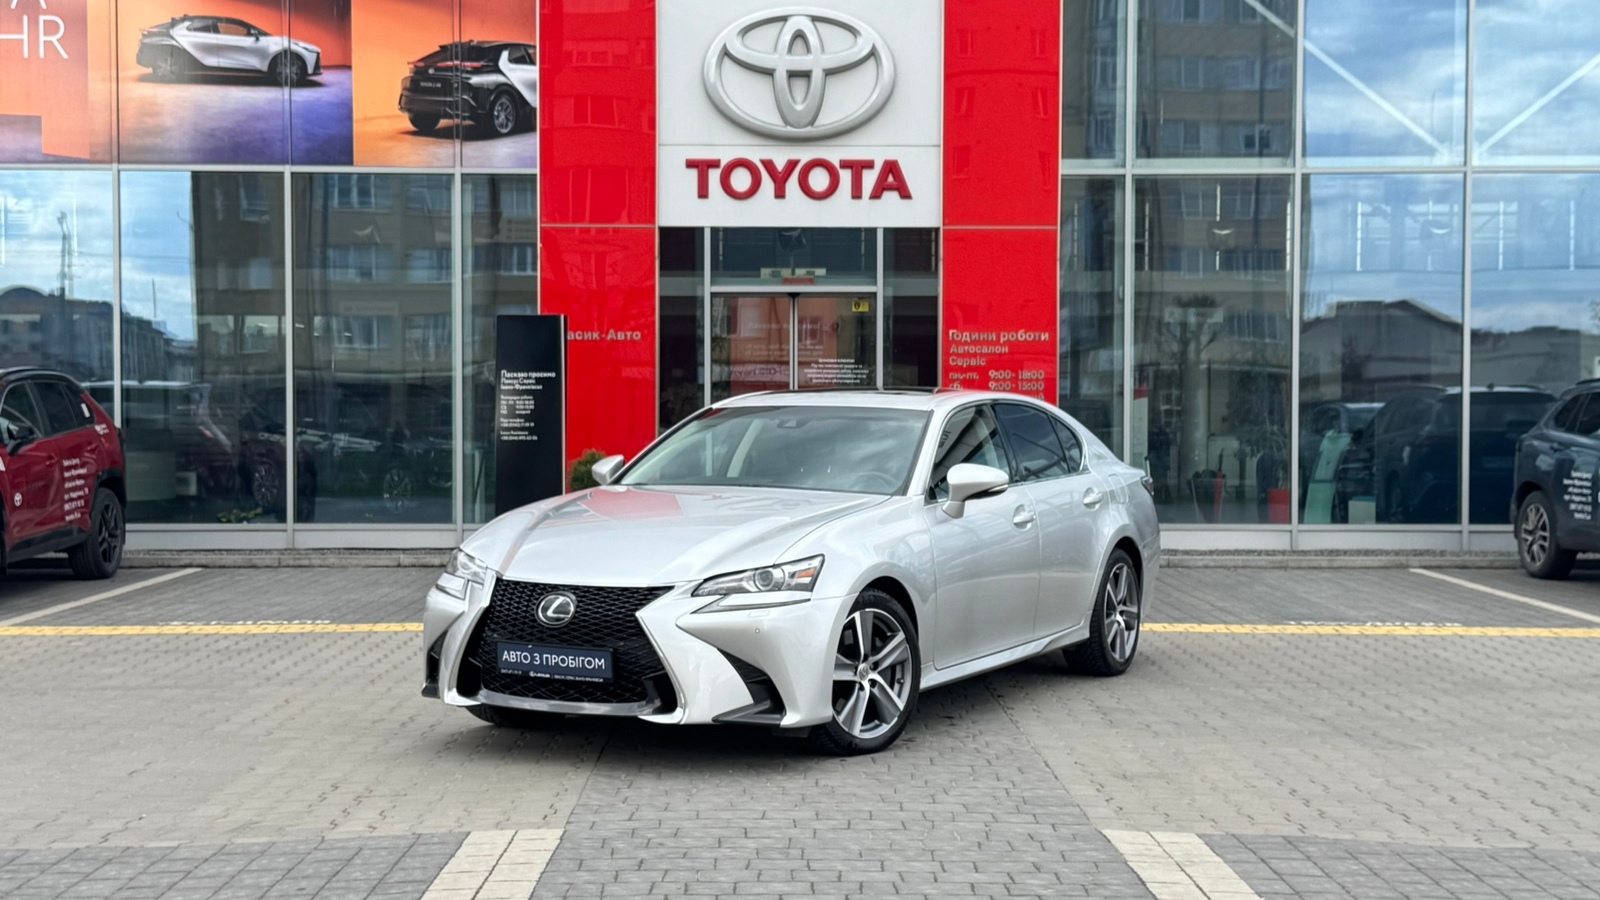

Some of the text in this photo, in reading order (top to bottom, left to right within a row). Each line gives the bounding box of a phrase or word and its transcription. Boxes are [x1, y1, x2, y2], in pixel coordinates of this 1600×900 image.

[685, 157, 913, 200] TOYOTA
[949, 329, 1049, 344] Години роботи
[950, 344, 1008, 354] Автосалон
[949, 356, 986, 368] Сервіс
[502, 650, 531, 664] АВТО
[543, 653, 605, 670] ПРОБІГОМ
